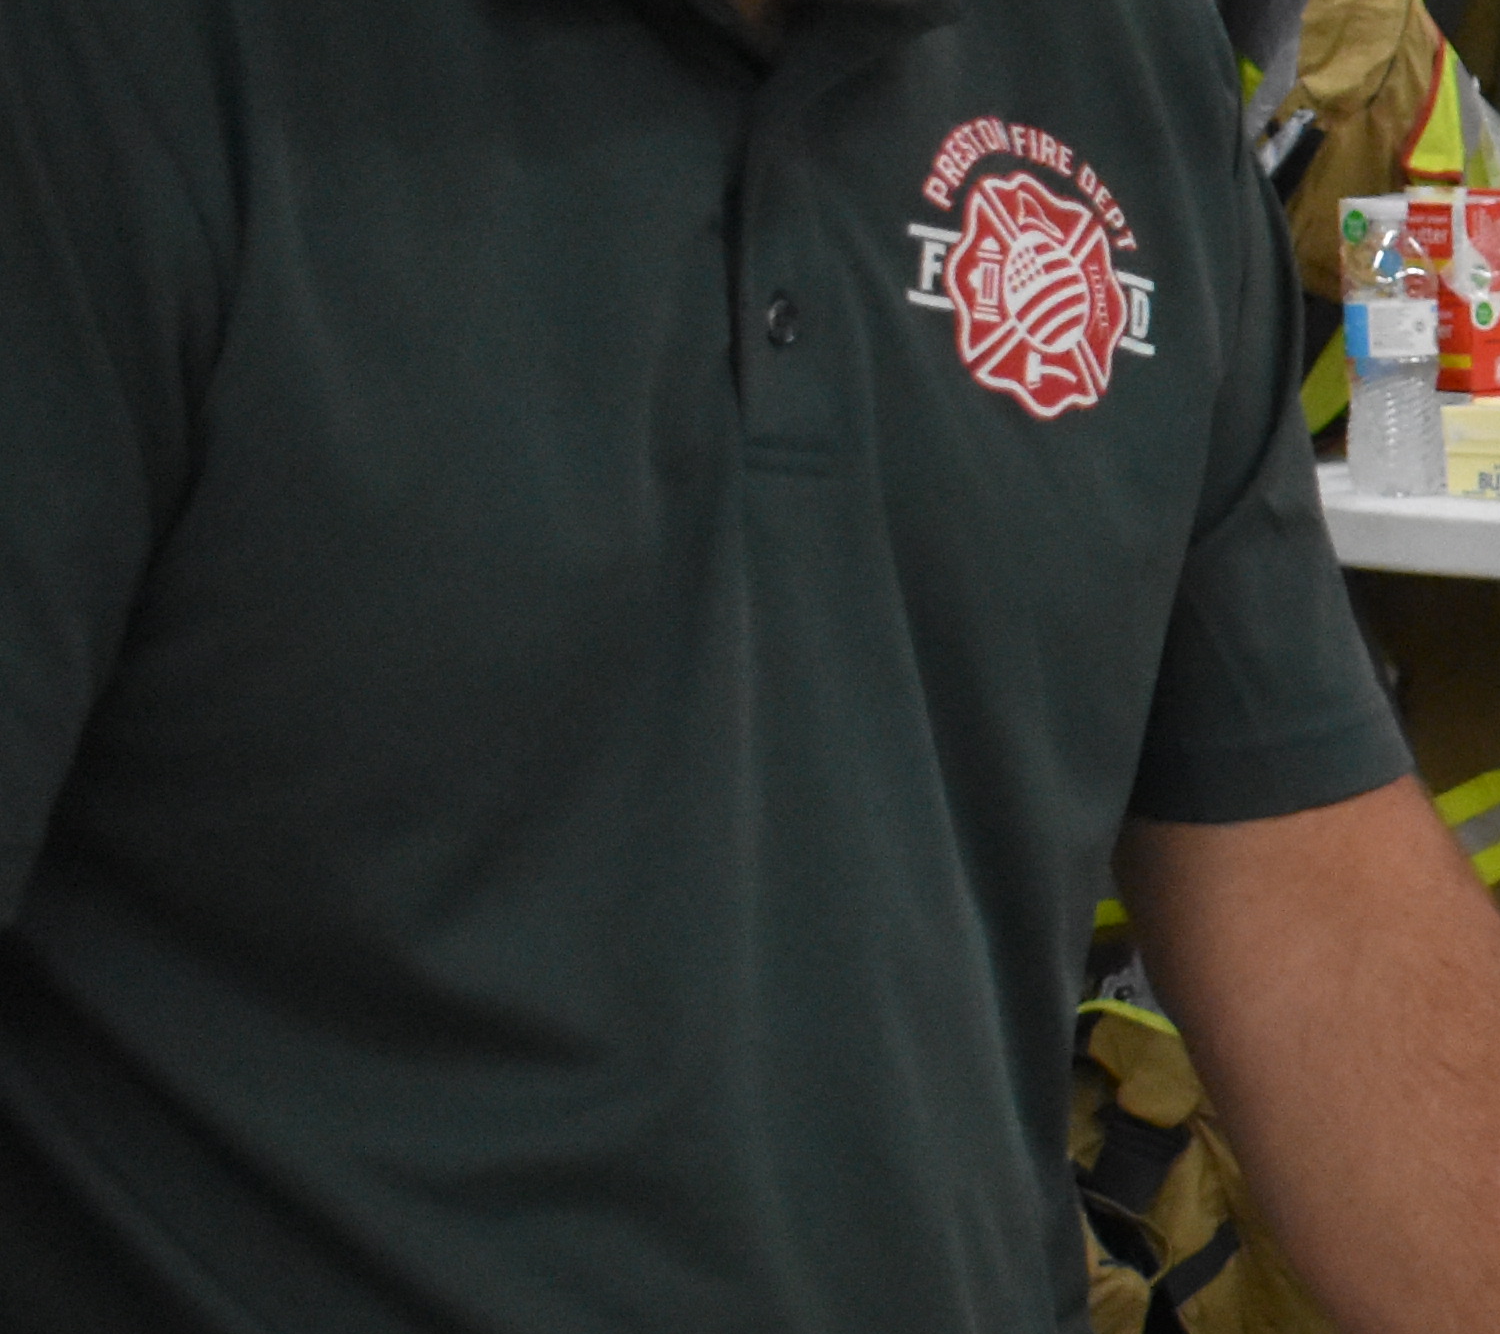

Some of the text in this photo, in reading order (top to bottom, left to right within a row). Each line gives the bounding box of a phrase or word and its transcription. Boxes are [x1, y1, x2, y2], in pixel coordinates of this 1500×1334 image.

[923, 115, 1138, 250] PRESTON FIRE DEPT
